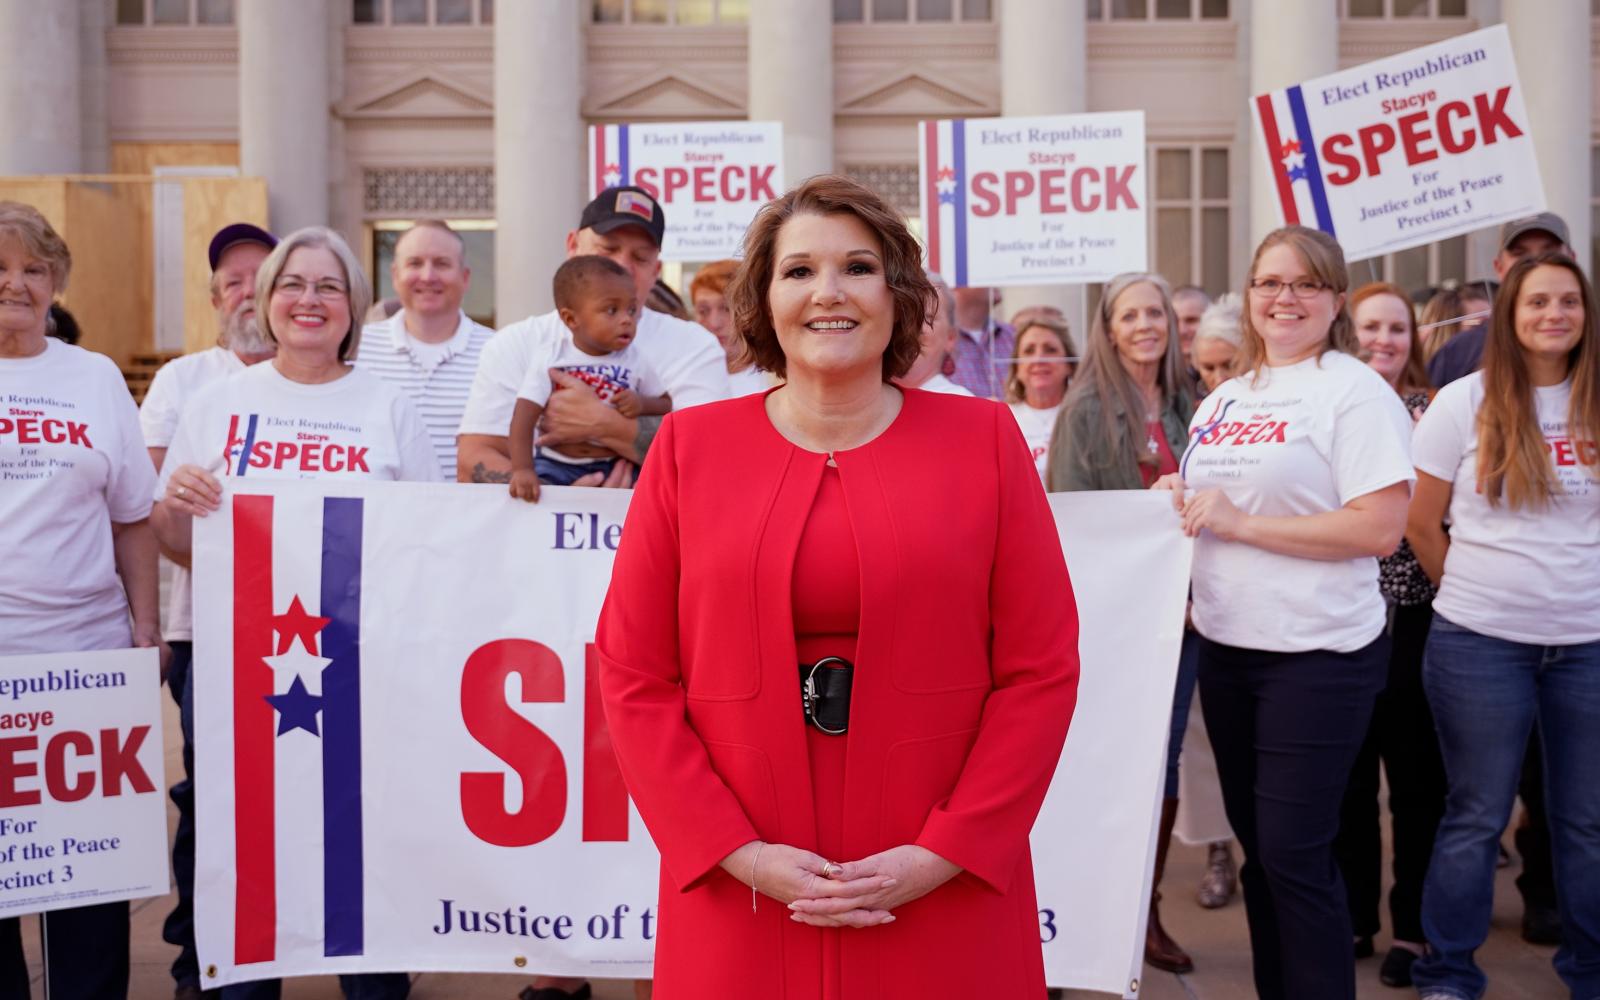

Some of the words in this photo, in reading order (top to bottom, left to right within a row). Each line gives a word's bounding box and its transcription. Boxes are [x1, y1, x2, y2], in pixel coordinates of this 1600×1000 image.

[1322, 81, 1370, 105] Elect
[1375, 48, 1487, 90] Republican
[1381, 89, 1437, 114] Stacye
[643, 134, 678, 146] Elect
[684, 132, 764, 147] Republican
[981, 130, 1022, 145] Elect
[1028, 125, 1123, 145] Republican
[1320, 85, 1524, 187] SPECK
[684, 152, 724, 164] Stacye
[1029, 151, 1076, 165] Stacye
[634, 164, 776, 204] SPECK
[1412, 170, 1439, 186] For
[971, 164, 1139, 218] SPECK
[1358, 201, 1409, 221] Justice
[1413, 193, 1429, 207] of
[1432, 184, 1456, 201] the
[1460, 172, 1504, 193] Peace
[1397, 206, 1458, 230] Precinct
[1462, 199, 1472, 214] 3
[1041, 221, 1064, 233] For
[991, 240, 1035, 253] Justice
[1038, 238, 1051, 250] of
[1055, 237, 1074, 250] the
[1079, 236, 1116, 249] Peace
[1021, 255, 1074, 268] Precinct
[8, 394, 76, 409] Republican
[9, 408, 45, 417] Stacye
[0, 418, 93, 449] PECK
[266, 417, 295, 427] Elect
[299, 418, 362, 433] Republican
[1200, 421, 1288, 446] SPECK
[297, 432, 330, 442] Stacye
[30, 459, 47, 468] the
[249, 441, 370, 473] SPECK
[551, 513, 622, 550] Ele
[0, 669, 126, 700] epublican
[0, 710, 54, 732] acye
[0, 725, 157, 809] ECK
[0, 818, 37, 836] For
[22, 842, 56, 861] the
[62, 836, 121, 856] Peace
[61, 865, 74, 883] 3
[433, 899, 573, 940] Justice
[587, 904, 630, 940] of
[1038, 908, 1057, 943] 3
